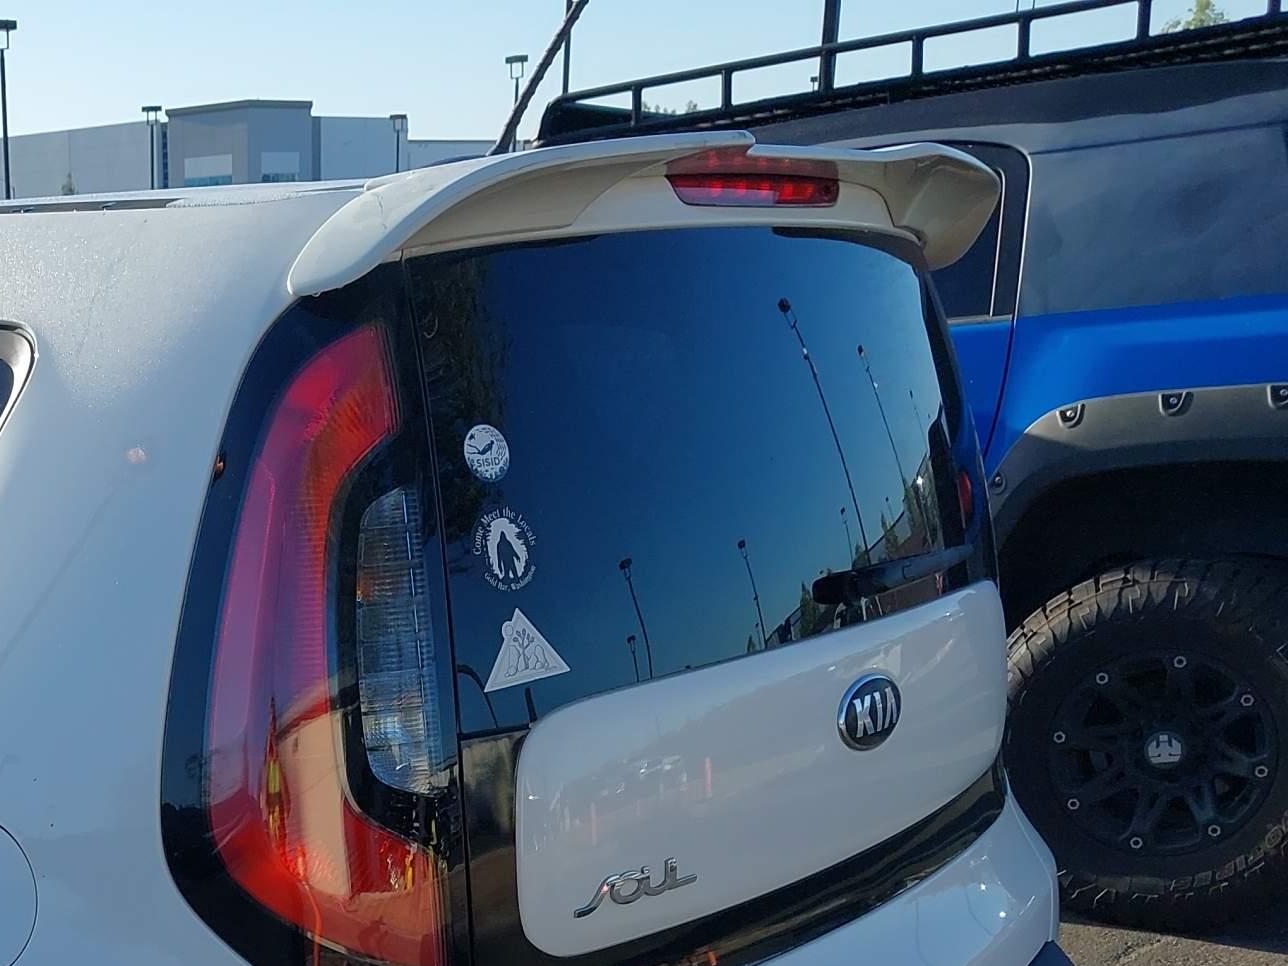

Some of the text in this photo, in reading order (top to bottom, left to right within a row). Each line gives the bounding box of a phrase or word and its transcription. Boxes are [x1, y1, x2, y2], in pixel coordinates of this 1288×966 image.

[473, 506, 537, 555] Come Meet the Locals
[852, 687, 898, 738] KIA
